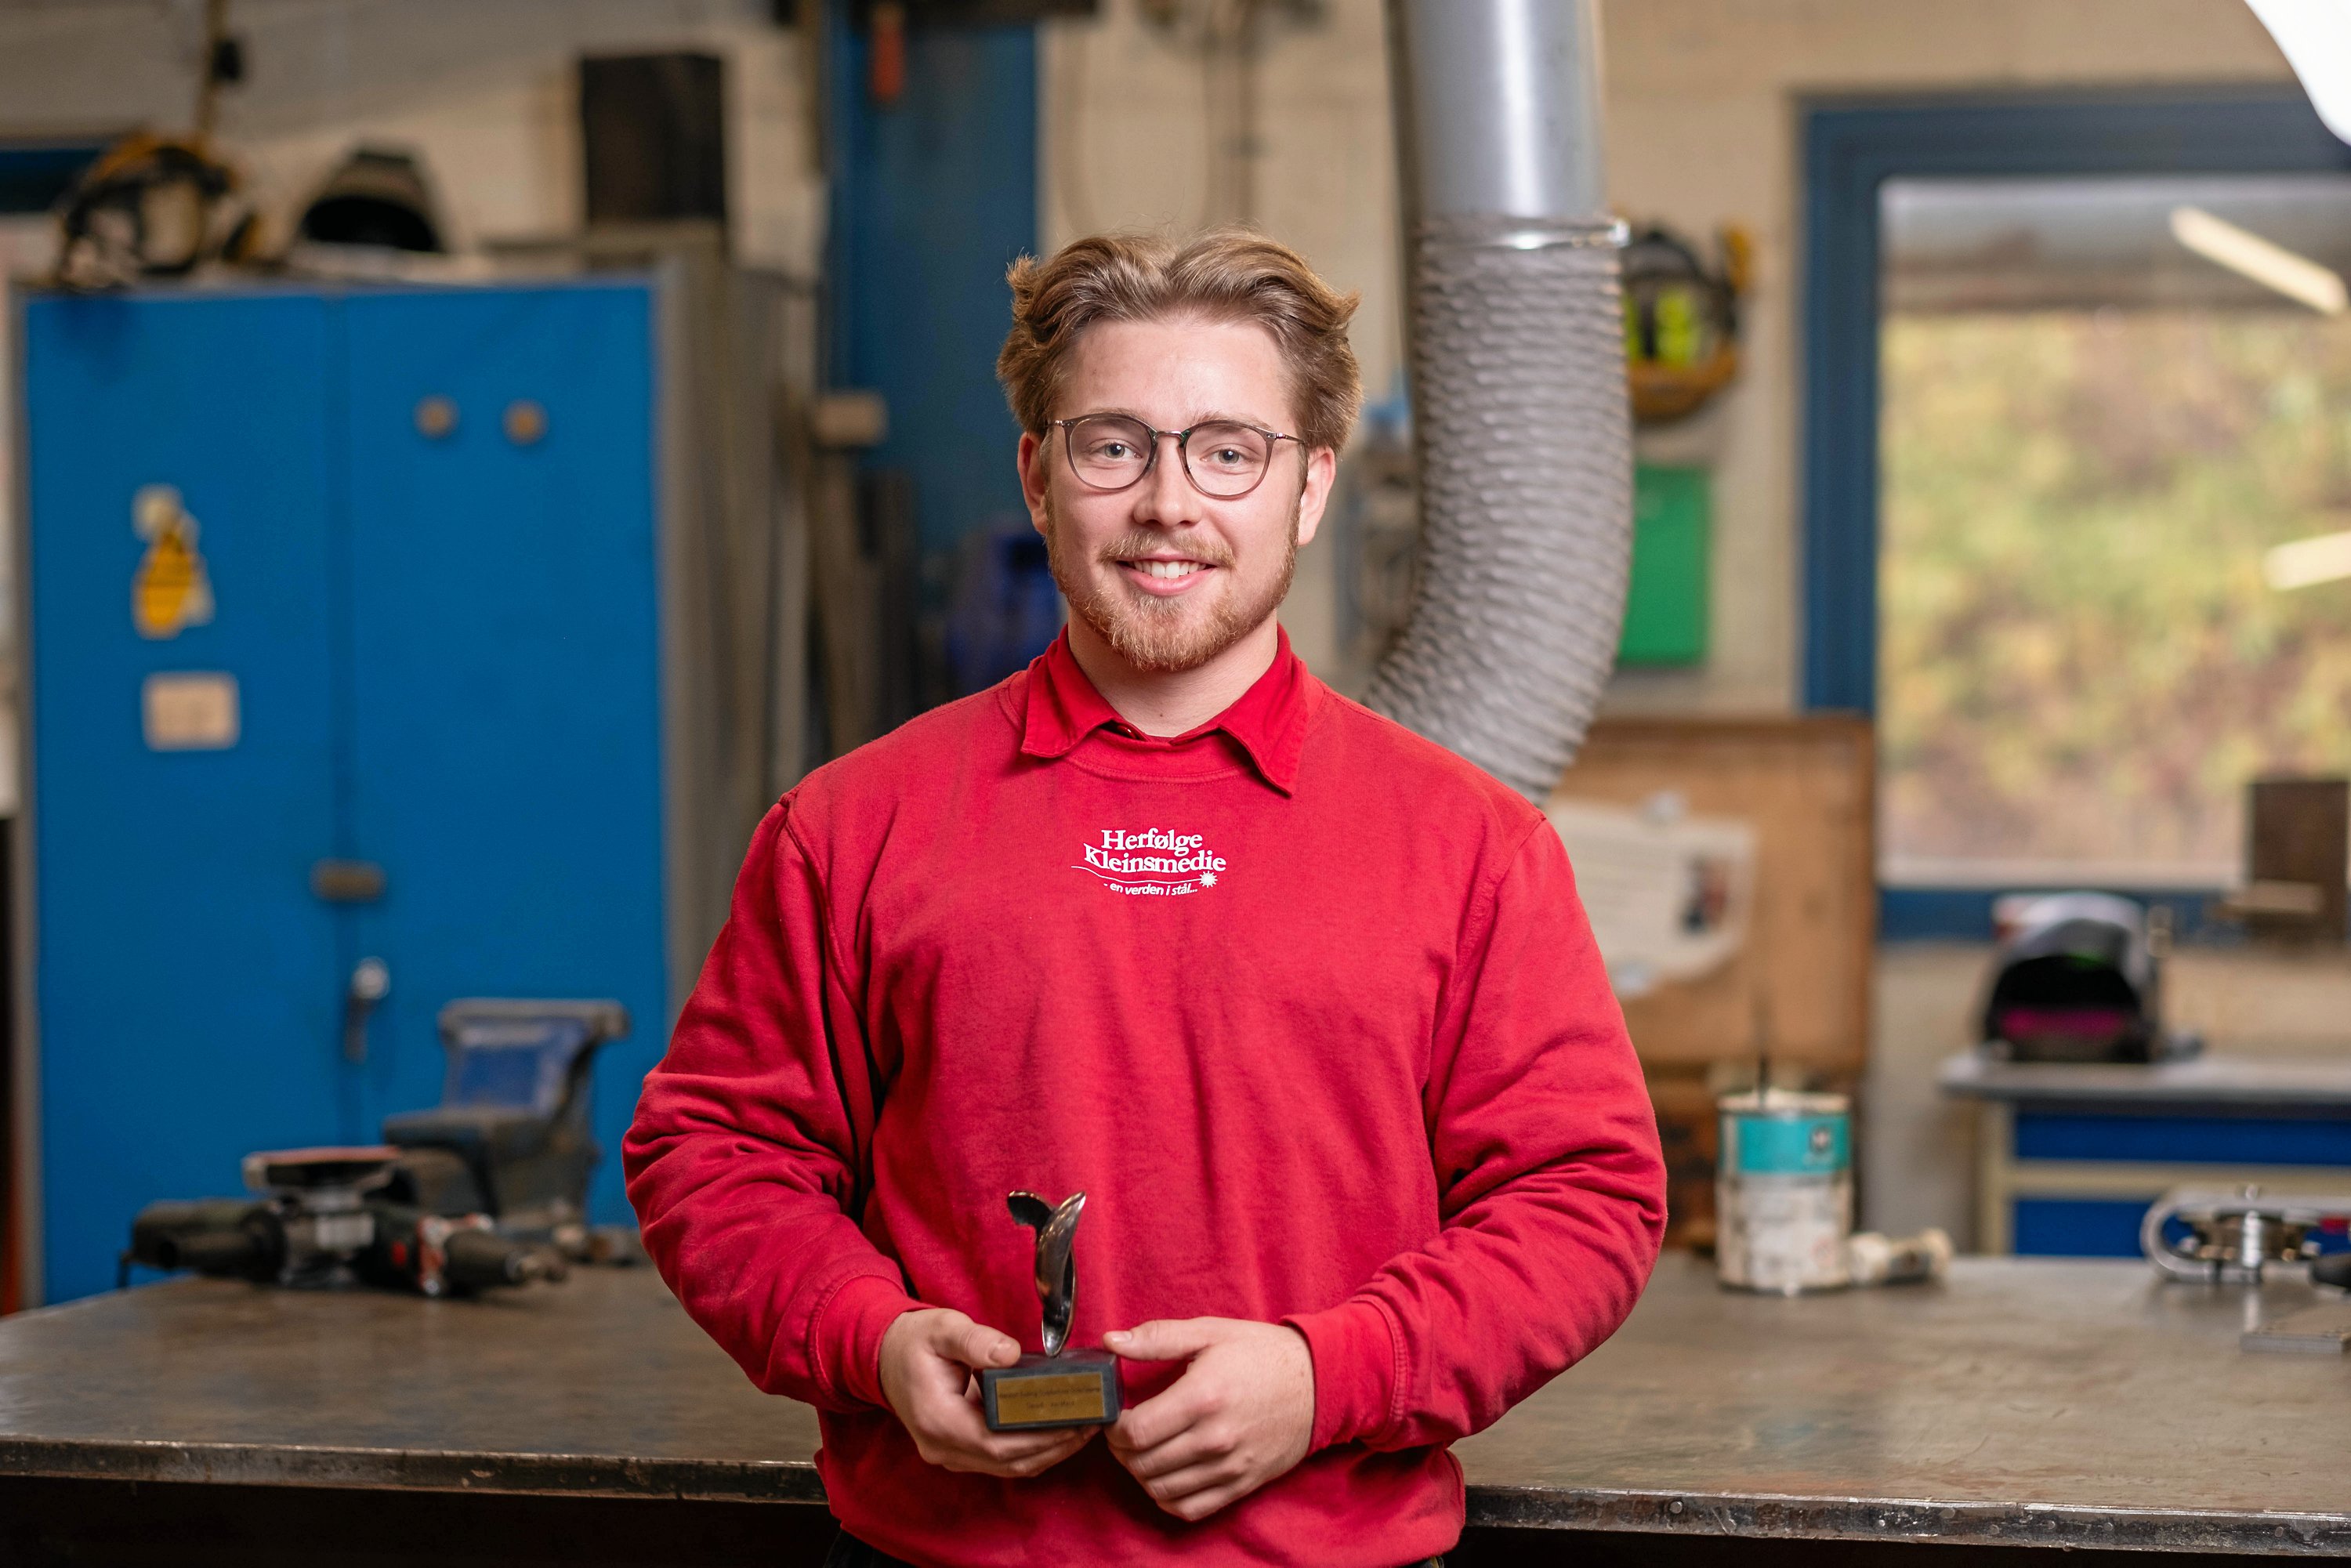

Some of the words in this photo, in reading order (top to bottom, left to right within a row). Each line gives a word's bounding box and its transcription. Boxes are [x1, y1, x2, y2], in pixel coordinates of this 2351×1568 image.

[1101, 827, 1203, 856] Herfølge
[1083, 843, 1226, 873] Kleinsmedie
[1125, 884, 1164, 895] verden
[1165, 885, 1171, 896] i
